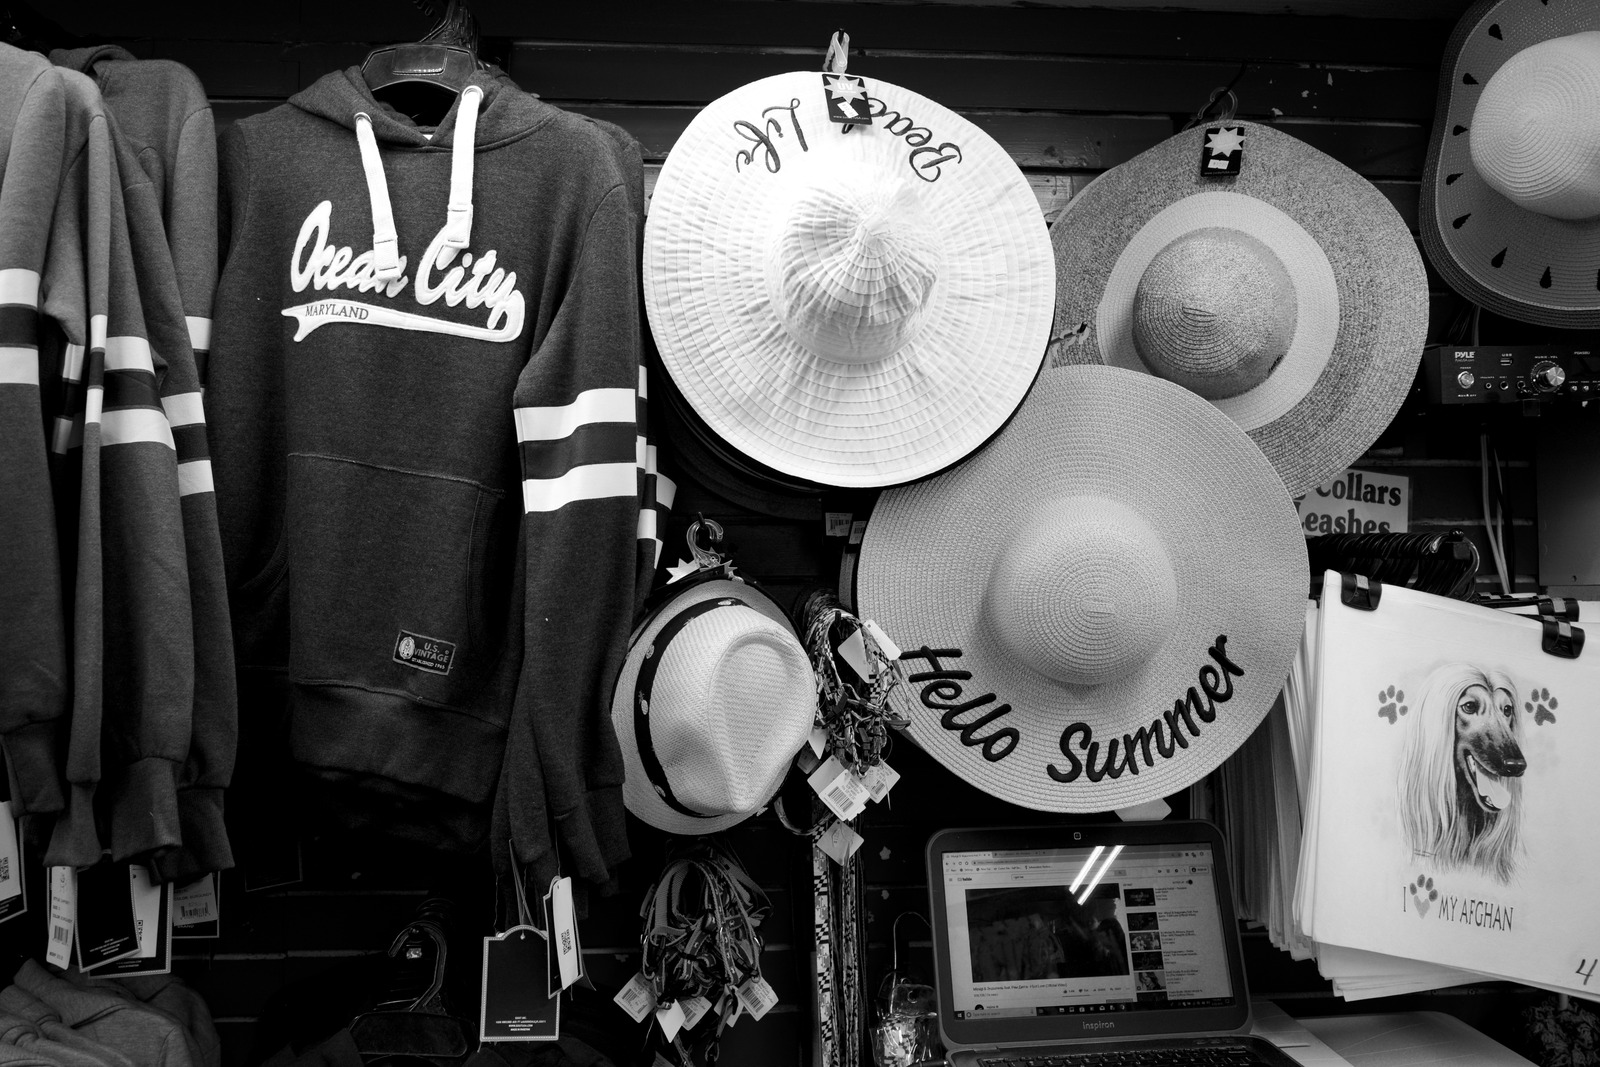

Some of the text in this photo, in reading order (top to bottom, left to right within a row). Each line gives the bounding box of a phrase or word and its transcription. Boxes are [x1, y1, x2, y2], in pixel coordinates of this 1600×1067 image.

[837, 82, 853, 91] UV
[733, 97, 809, 174] Life
[414, 224, 525, 342] City
[305, 303, 370, 320] MARYLAND
[1454, 351, 1476, 359] PYLE
[414, 648, 449, 663] VINTAGE
[424, 642, 440, 653] U.S.
[900, 634, 1245, 783] Hello Summer
[1403, 886, 1515, 932] I MY AFGHAN
[1575, 958, 1599, 986] 4
[1082, 1020, 1115, 1032] inspiron
